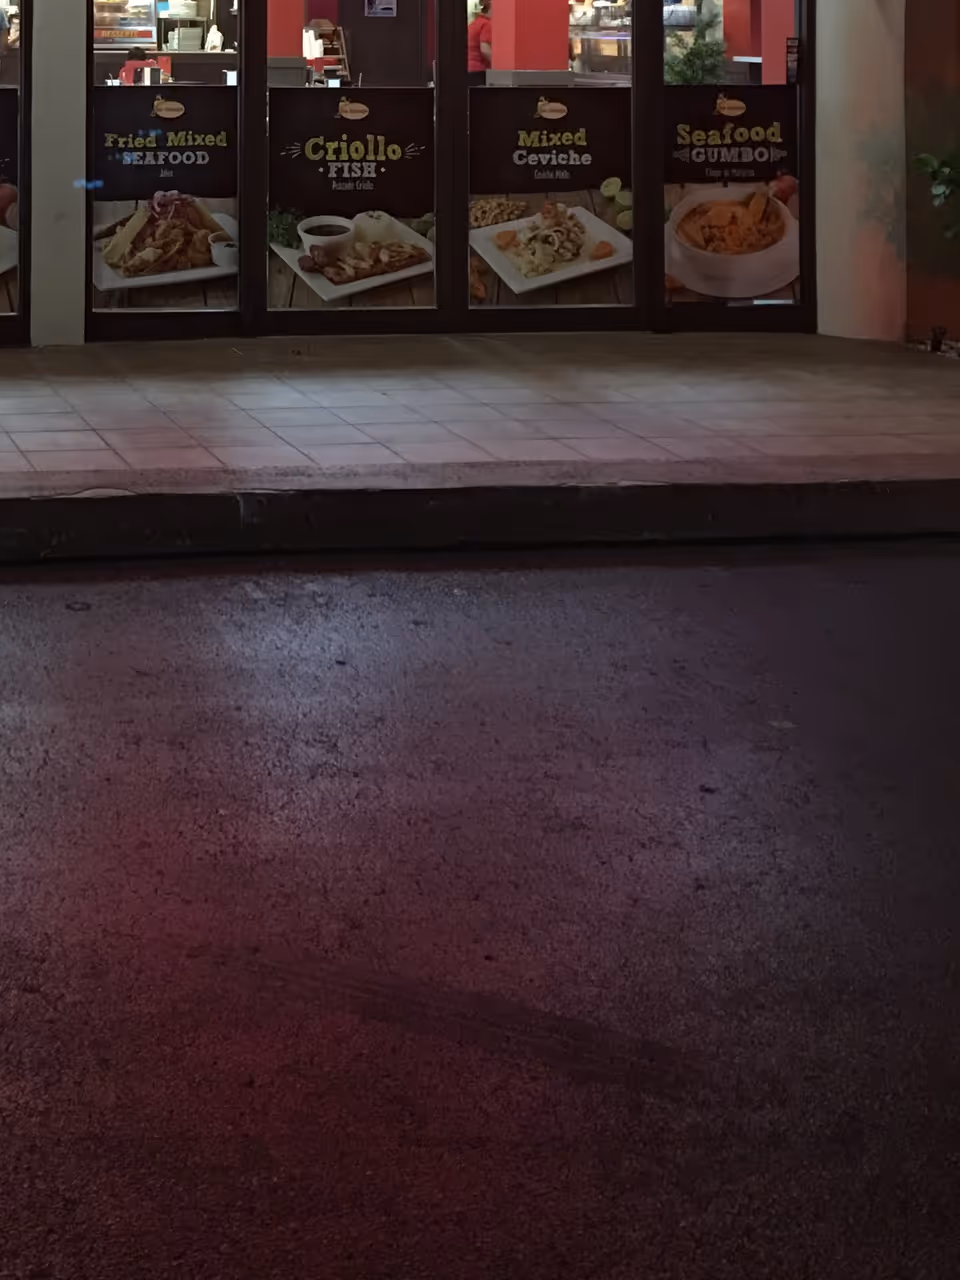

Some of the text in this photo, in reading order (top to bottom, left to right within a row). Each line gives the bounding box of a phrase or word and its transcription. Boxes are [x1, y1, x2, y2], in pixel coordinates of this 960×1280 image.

[103, 130, 228, 149] Fried Mixed
[517, 128, 588, 147] Mixed
[676, 121, 784, 146] Seafood
[303, 133, 403, 161] Criollo
[691, 146, 770, 163] GUMBO
[122, 151, 210, 165] SEAFOOD
[512, 150, 593, 166] Ceviche
[327, 161, 377, 178] FISH
